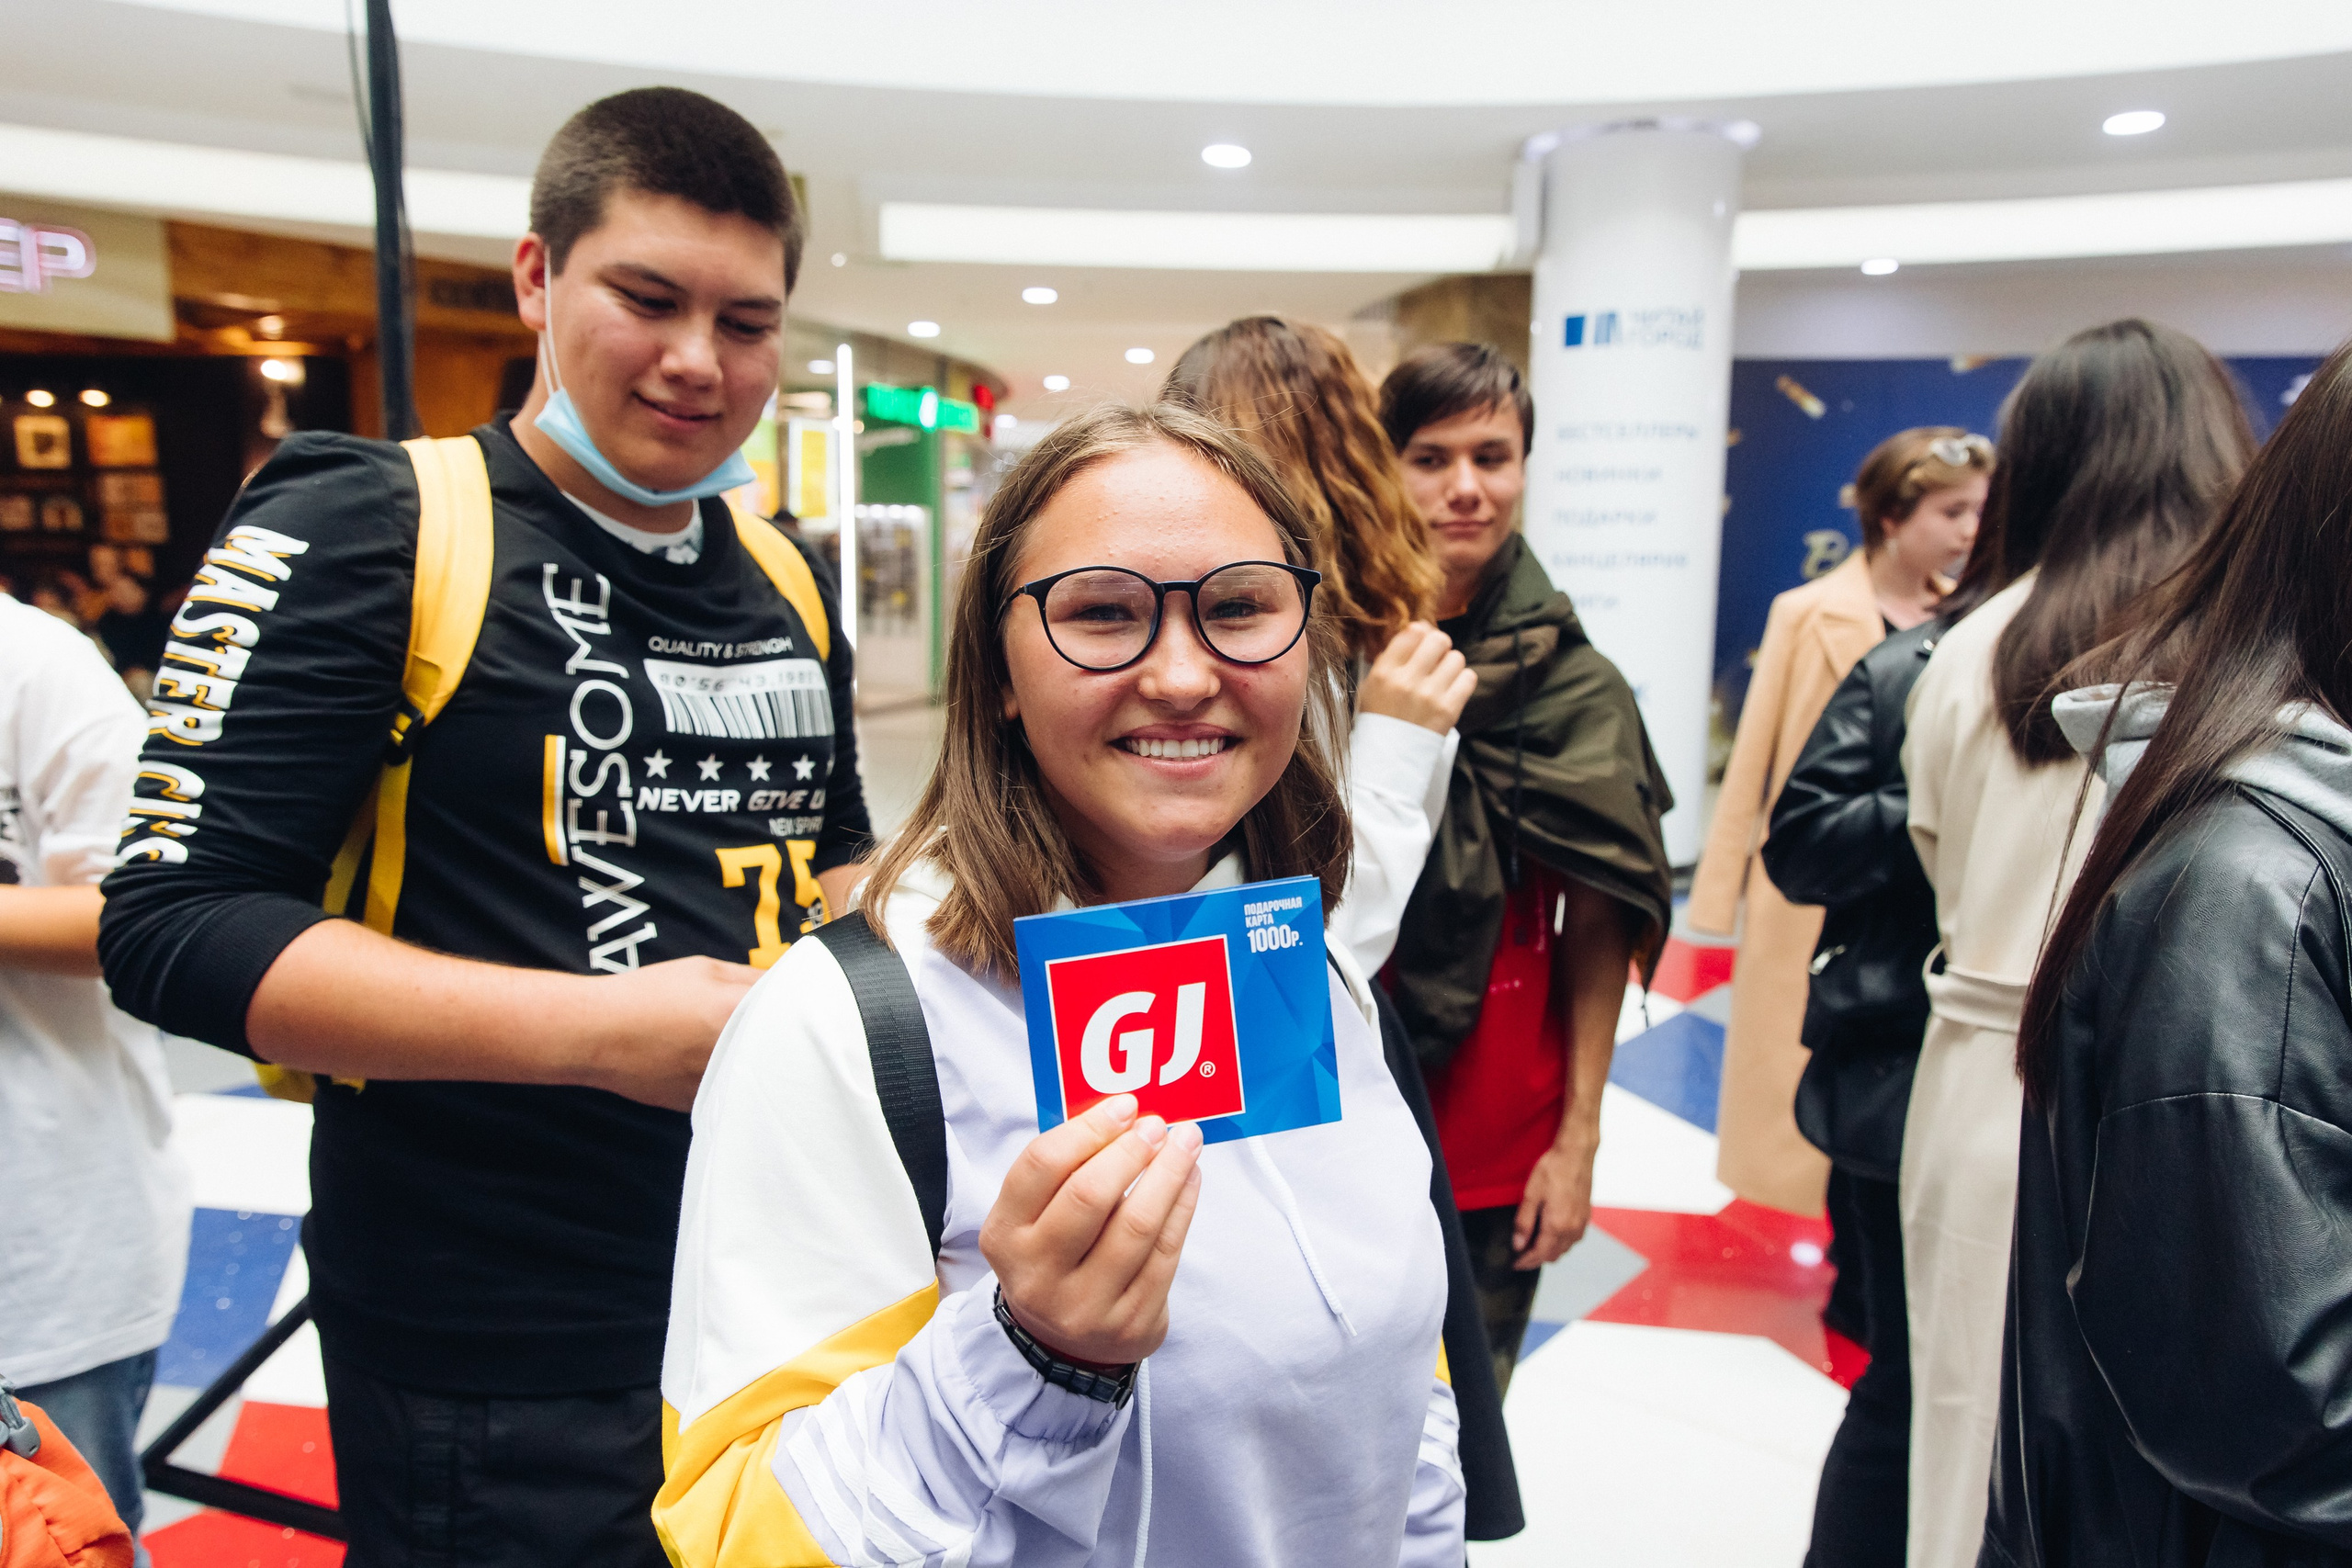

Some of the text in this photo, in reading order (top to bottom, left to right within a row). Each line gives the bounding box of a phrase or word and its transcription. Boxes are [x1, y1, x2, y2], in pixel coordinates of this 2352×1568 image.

[146, 525, 311, 746] MASTER
[648, 636, 724, 659] QUALITY
[543, 562, 657, 975] AWESOME
[636, 786, 827, 812] NEVER GIVE U
[715, 840, 833, 970] 75
[1244, 897, 1303, 916] ПОДАРОЧНАЯ
[1245, 913, 1274, 928] КАРТА
